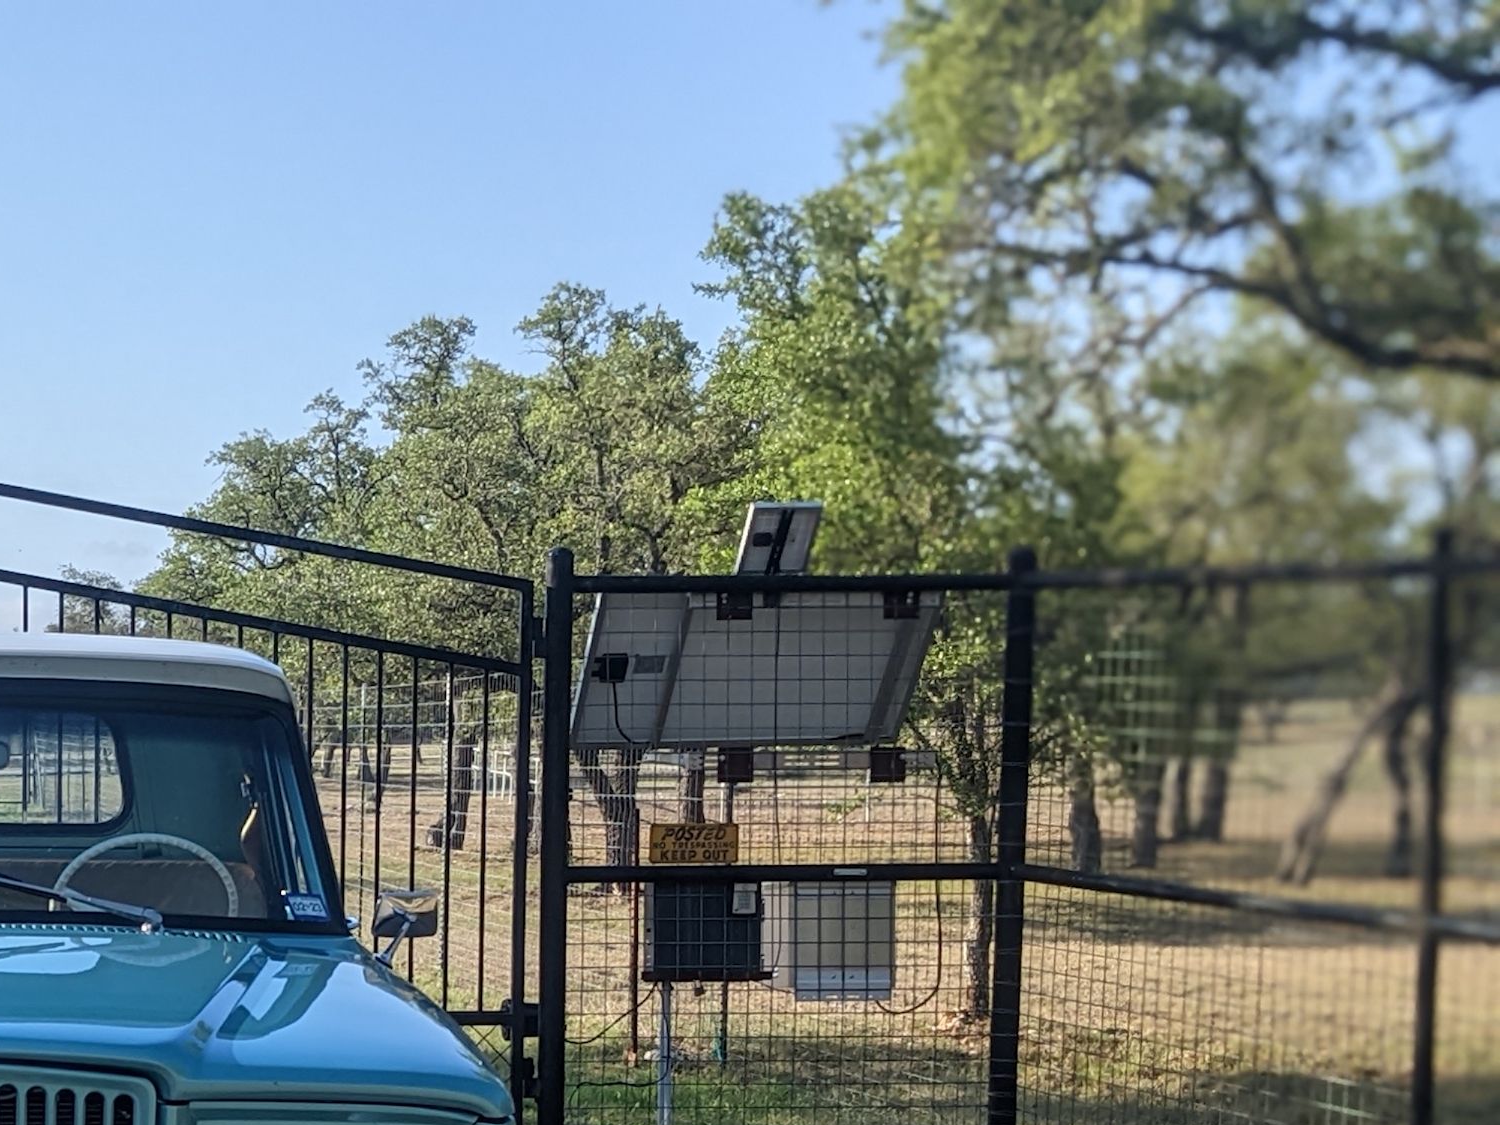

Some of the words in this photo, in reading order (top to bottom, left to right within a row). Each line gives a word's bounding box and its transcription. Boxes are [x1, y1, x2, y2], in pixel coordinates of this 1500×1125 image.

[661, 826, 727, 841] POSTED
[672, 841, 735, 849] TRESPASSING
[660, 850, 697, 861] KEEP
[703, 849, 729, 861] OUT
